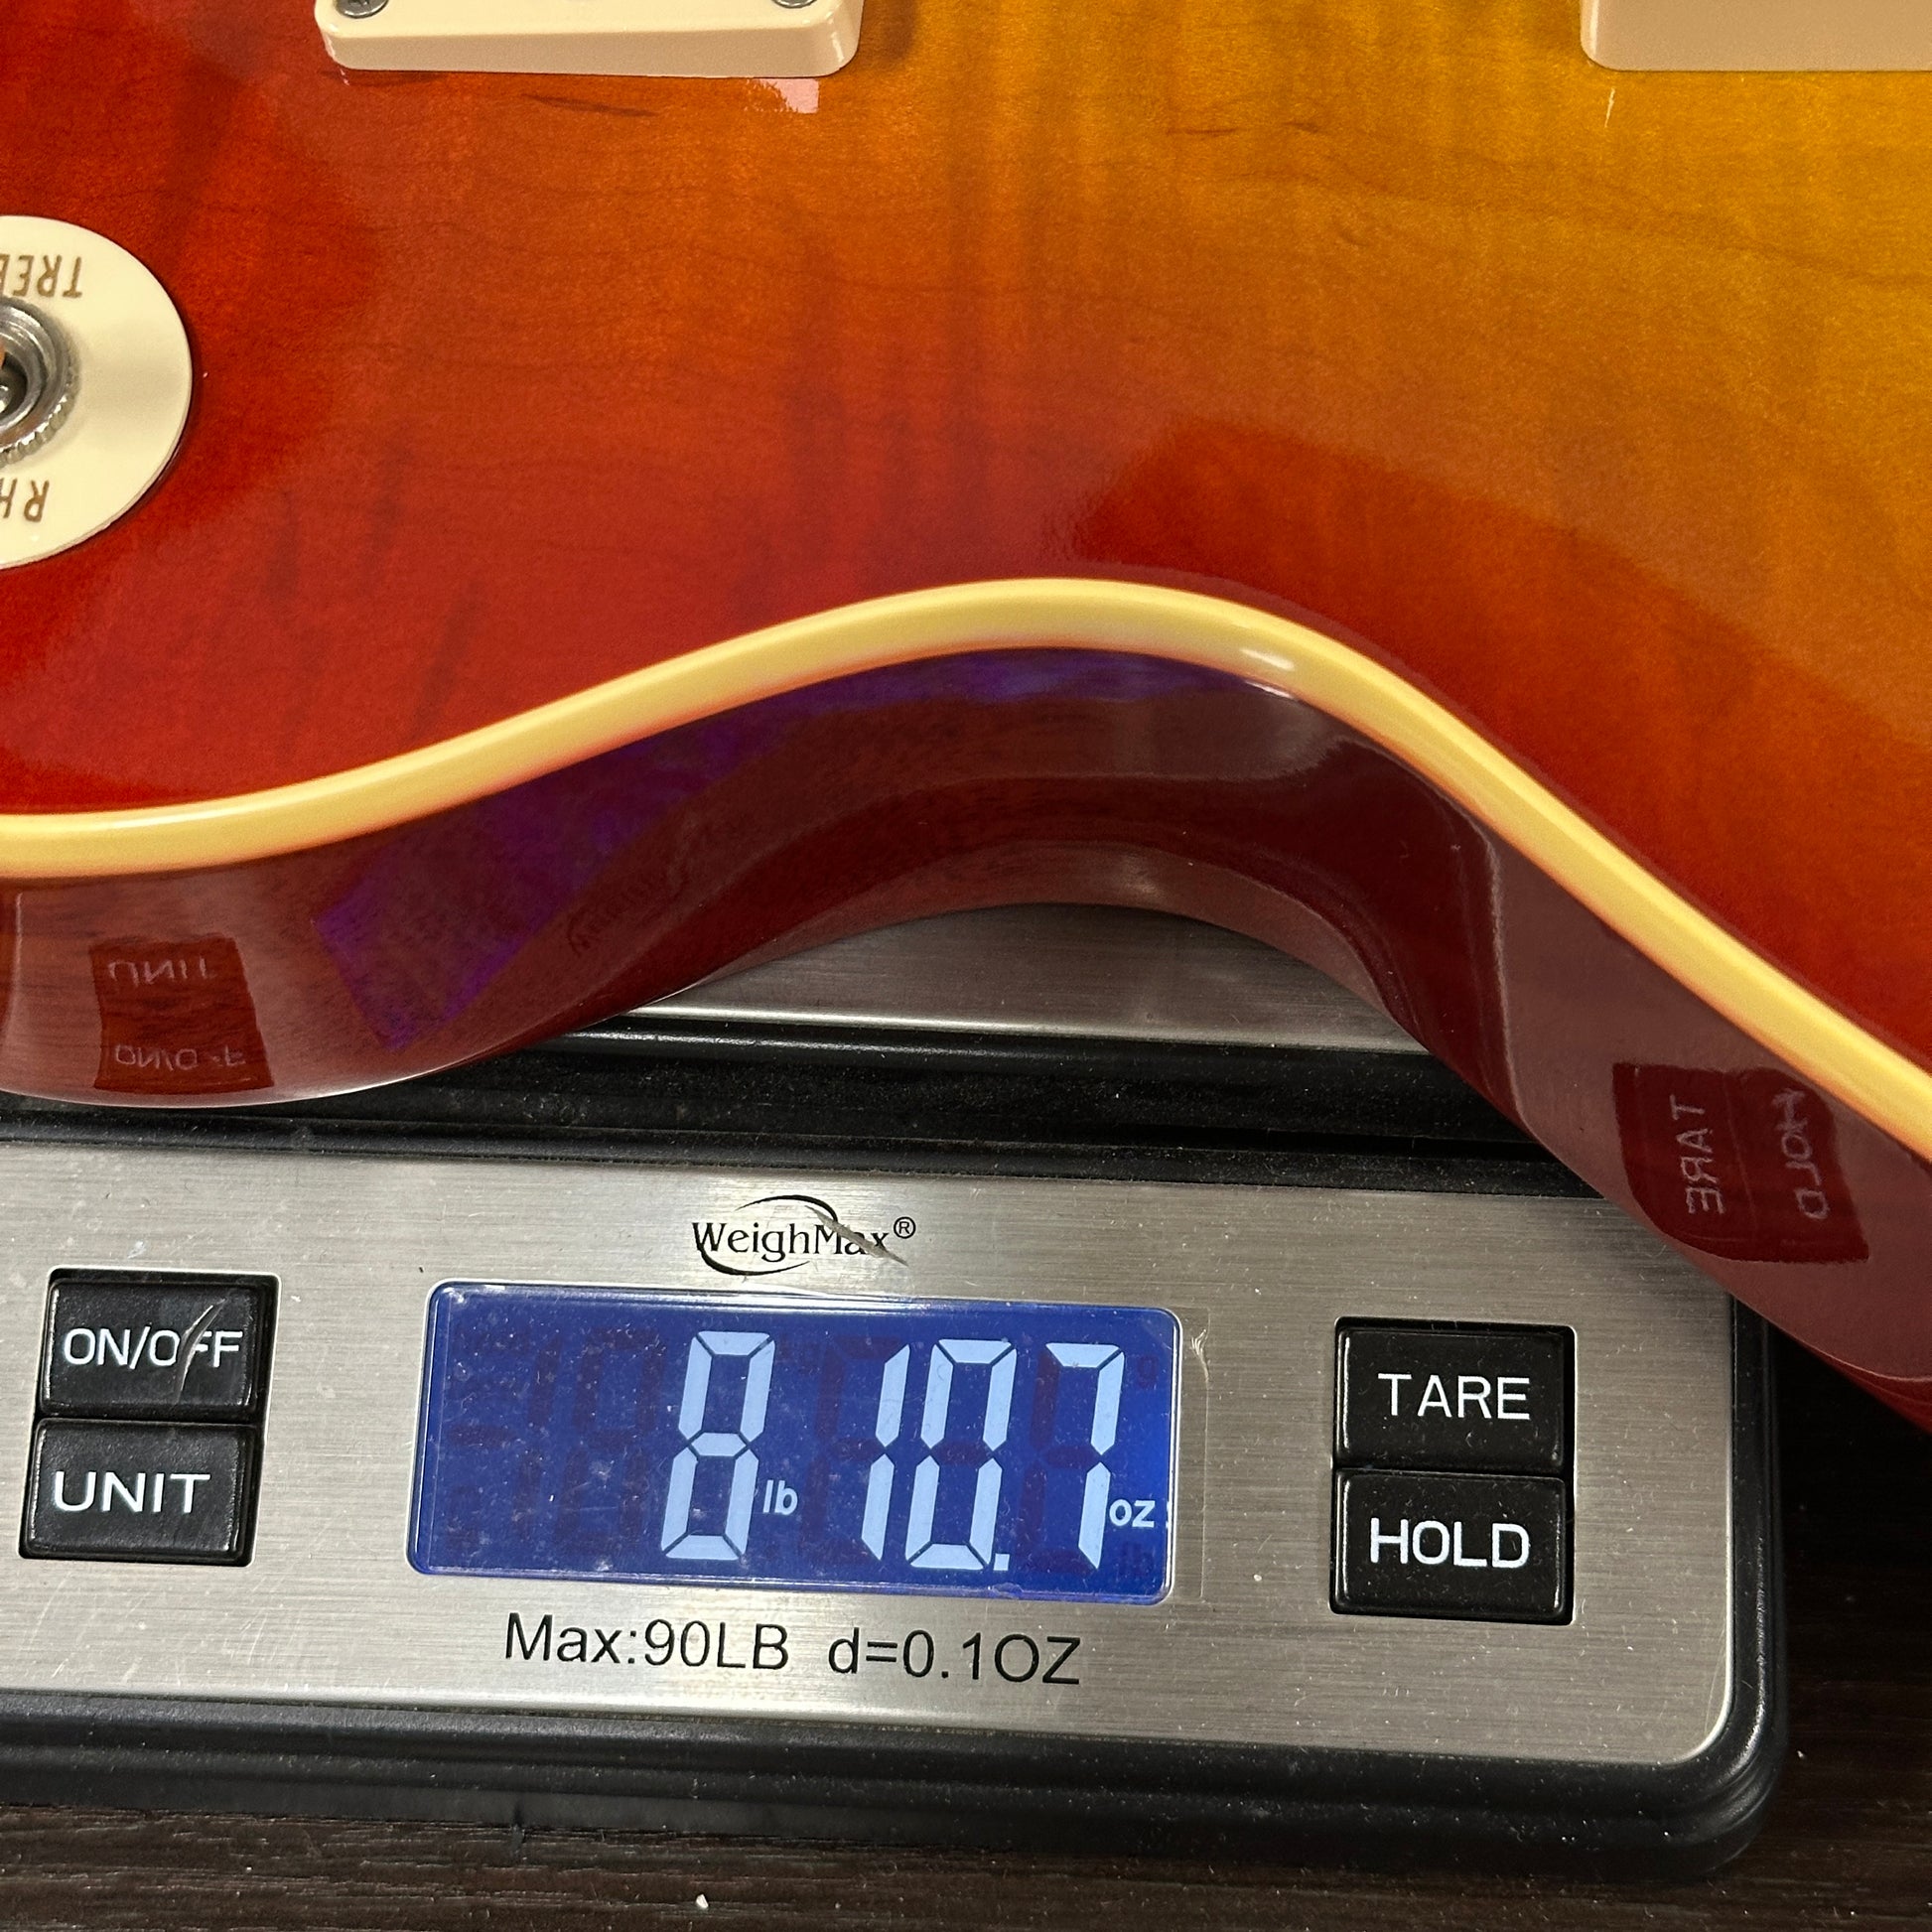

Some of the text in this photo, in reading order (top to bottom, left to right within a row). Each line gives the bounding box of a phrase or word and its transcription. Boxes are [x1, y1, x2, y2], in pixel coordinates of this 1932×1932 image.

[1377, 1372, 1530, 1420] TARE
[762, 1479, 798, 1515] lb
[862, 1339, 1125, 1572] 10.7
[55, 1470, 210, 1514] UNIT
[1369, 1517, 1531, 1569] HOLD
[505, 1611, 789, 1671] Max:90LB
